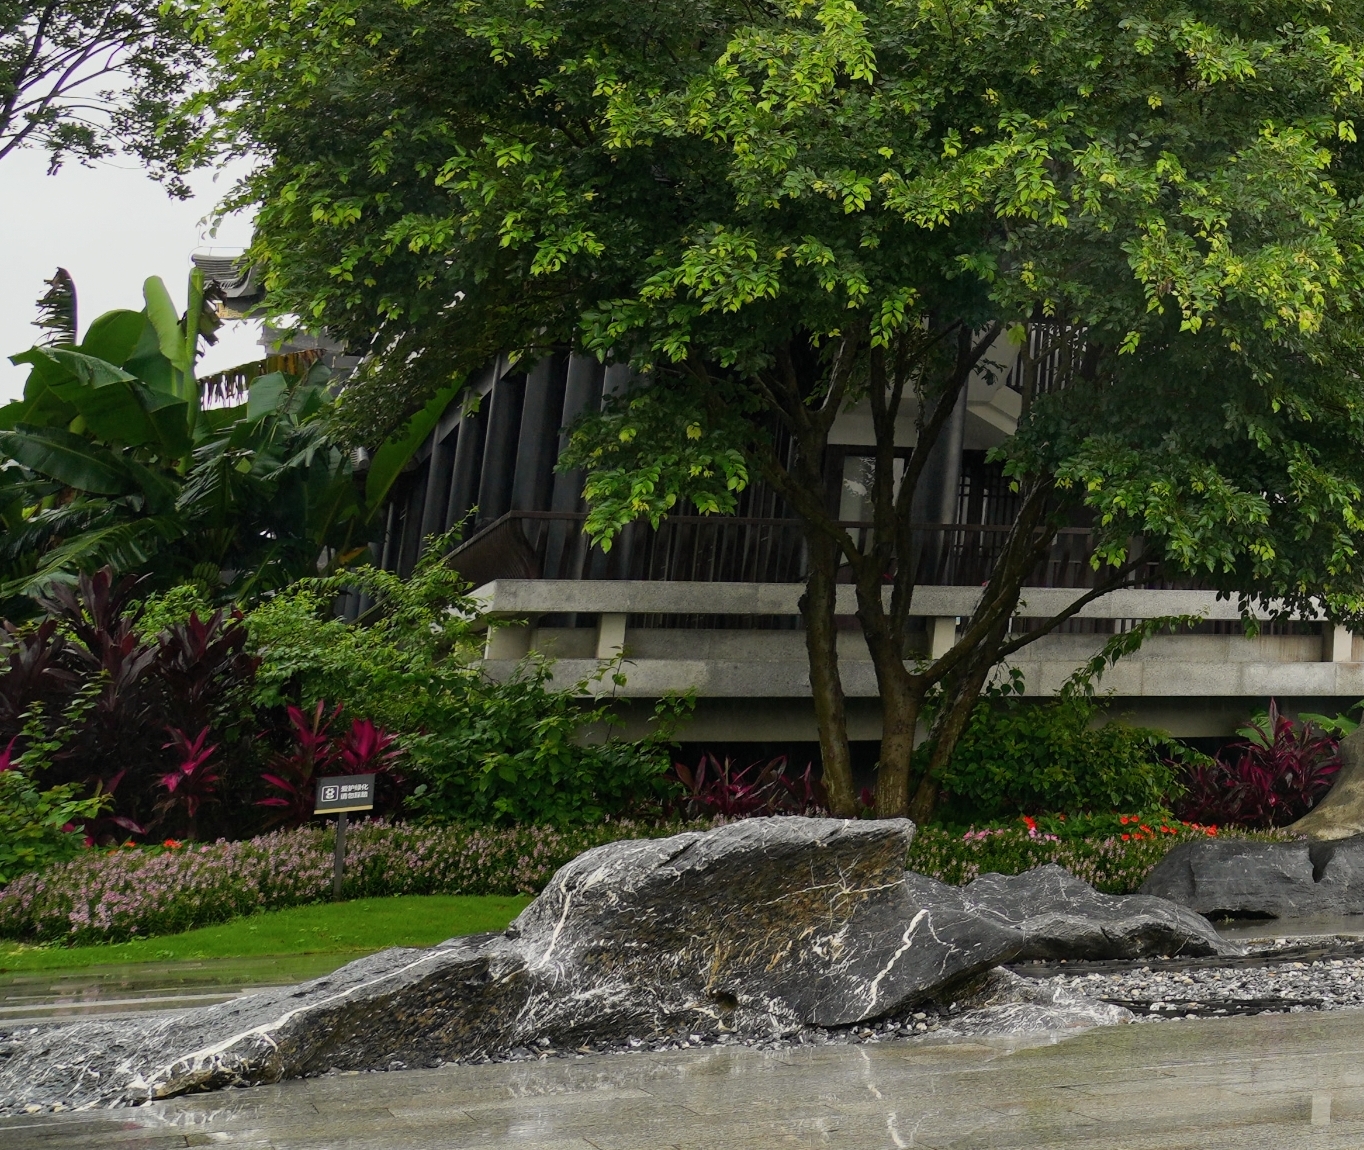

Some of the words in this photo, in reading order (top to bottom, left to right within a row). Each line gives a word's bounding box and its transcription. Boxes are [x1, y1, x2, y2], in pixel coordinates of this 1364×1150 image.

[341, 784, 369, 792] 爱护绿化
[340, 791, 368, 800] 请勿踩踏
